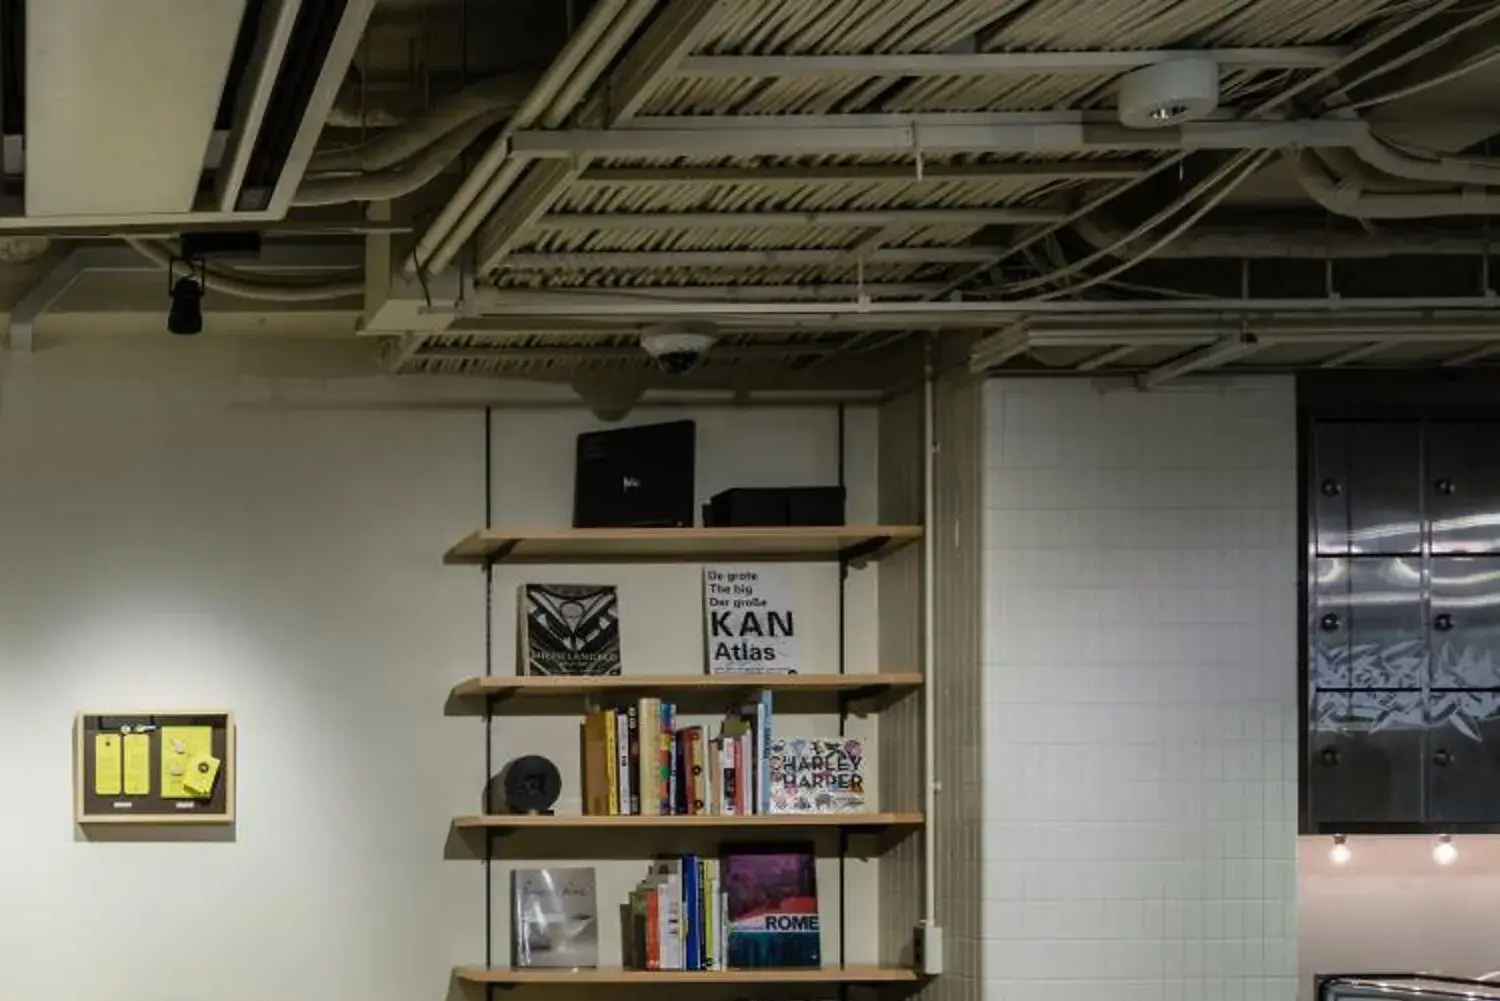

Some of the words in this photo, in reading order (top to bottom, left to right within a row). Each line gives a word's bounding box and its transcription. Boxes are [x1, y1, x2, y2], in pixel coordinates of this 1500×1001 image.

[709, 584, 730, 594] The
[733, 584, 753, 596] big
[711, 611, 794, 637] KAN
[714, 641, 777, 661] Atlas
[765, 915, 819, 931] ROME
